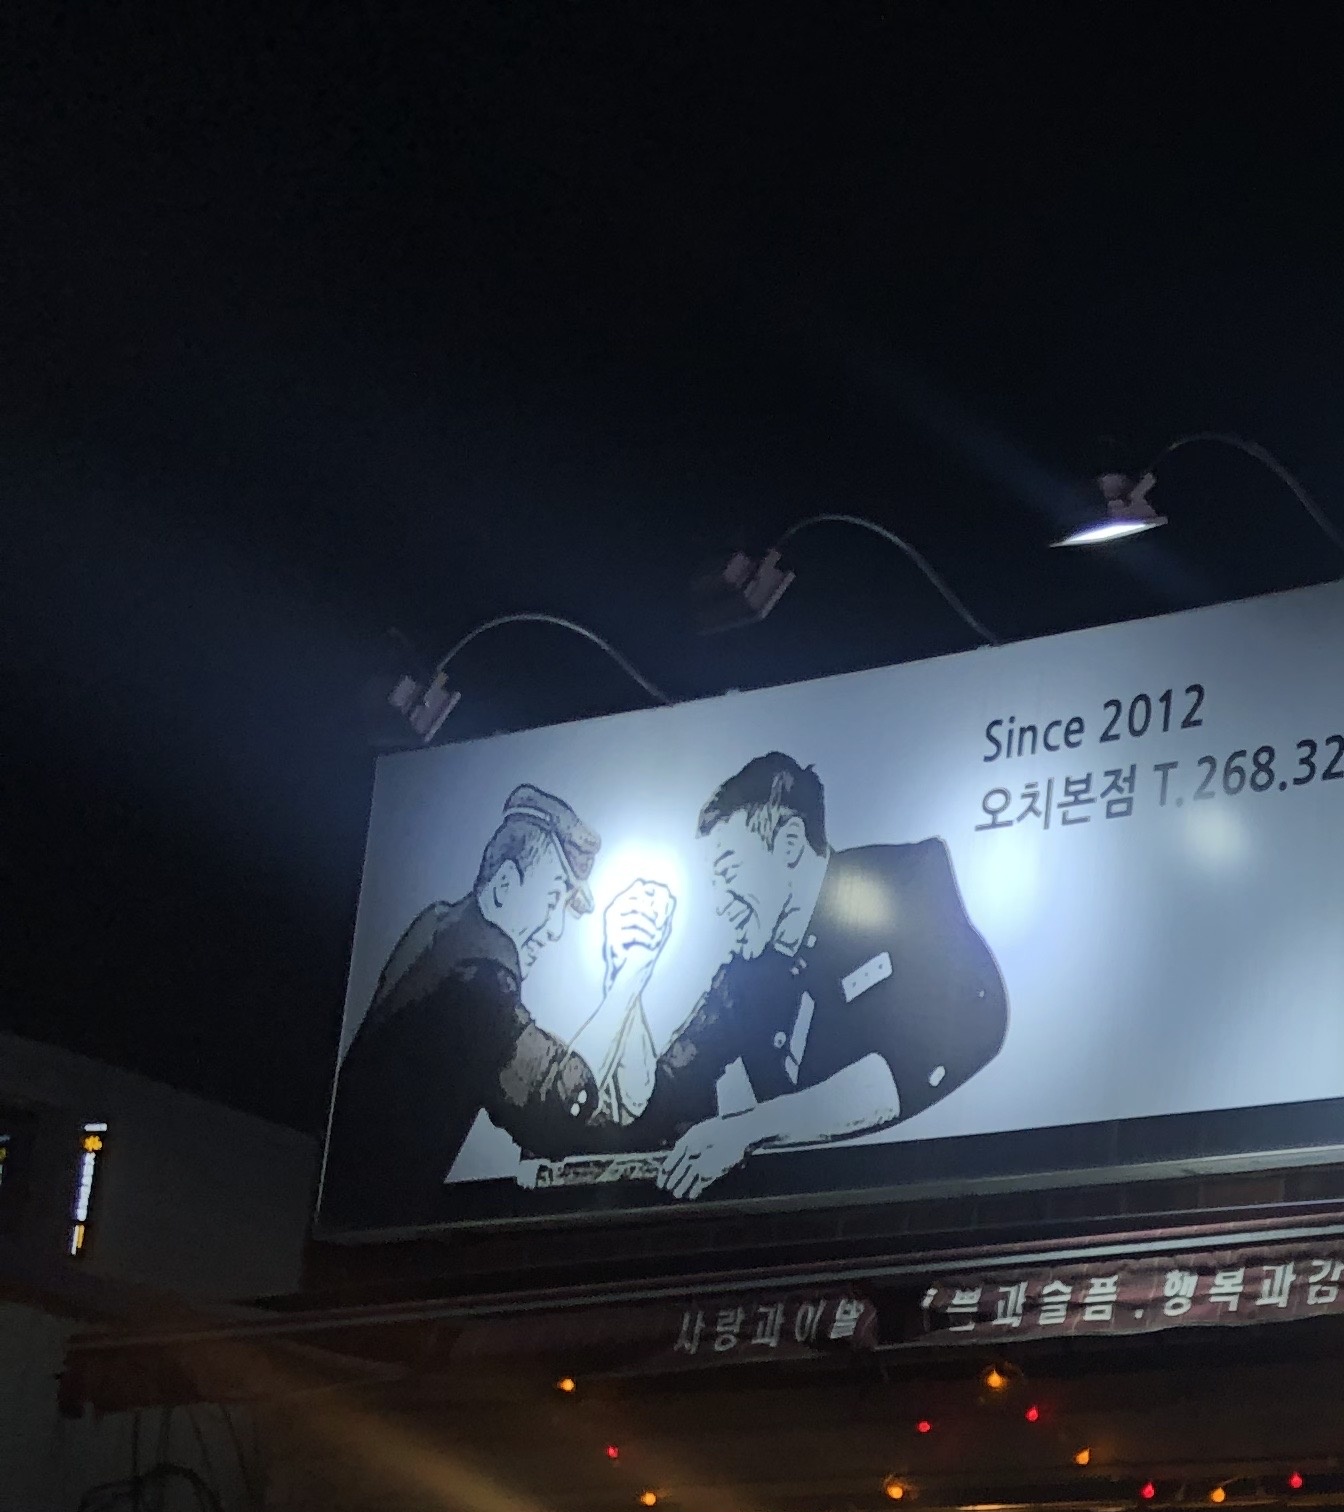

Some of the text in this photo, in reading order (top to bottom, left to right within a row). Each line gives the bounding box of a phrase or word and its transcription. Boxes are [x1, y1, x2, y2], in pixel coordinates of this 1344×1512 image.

[983, 684, 1206, 762] Since 2012
[975, 763, 1138, 831] 오치본점
